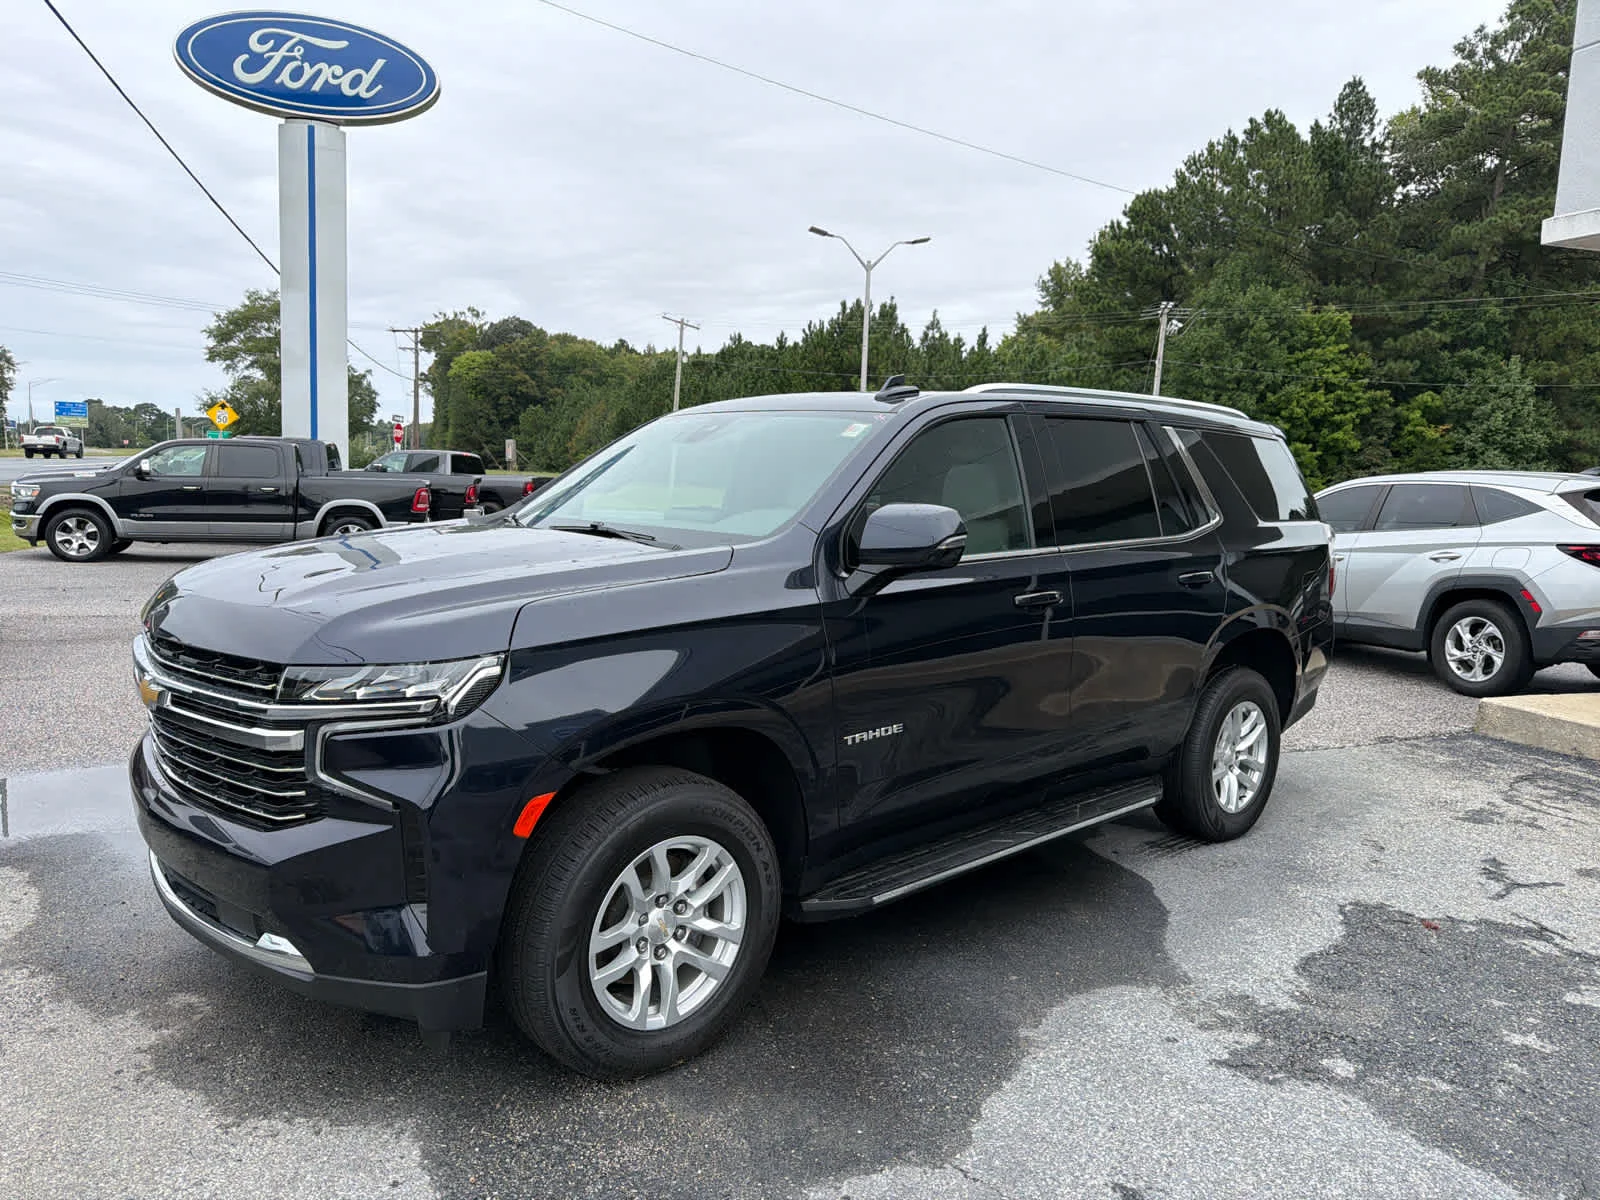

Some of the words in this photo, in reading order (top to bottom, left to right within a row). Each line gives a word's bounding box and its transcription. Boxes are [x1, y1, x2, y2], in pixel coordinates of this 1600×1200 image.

[233, 27, 388, 99] Ford
[217, 415, 228, 424] 50
[843, 723, 904, 746] TAHOE
